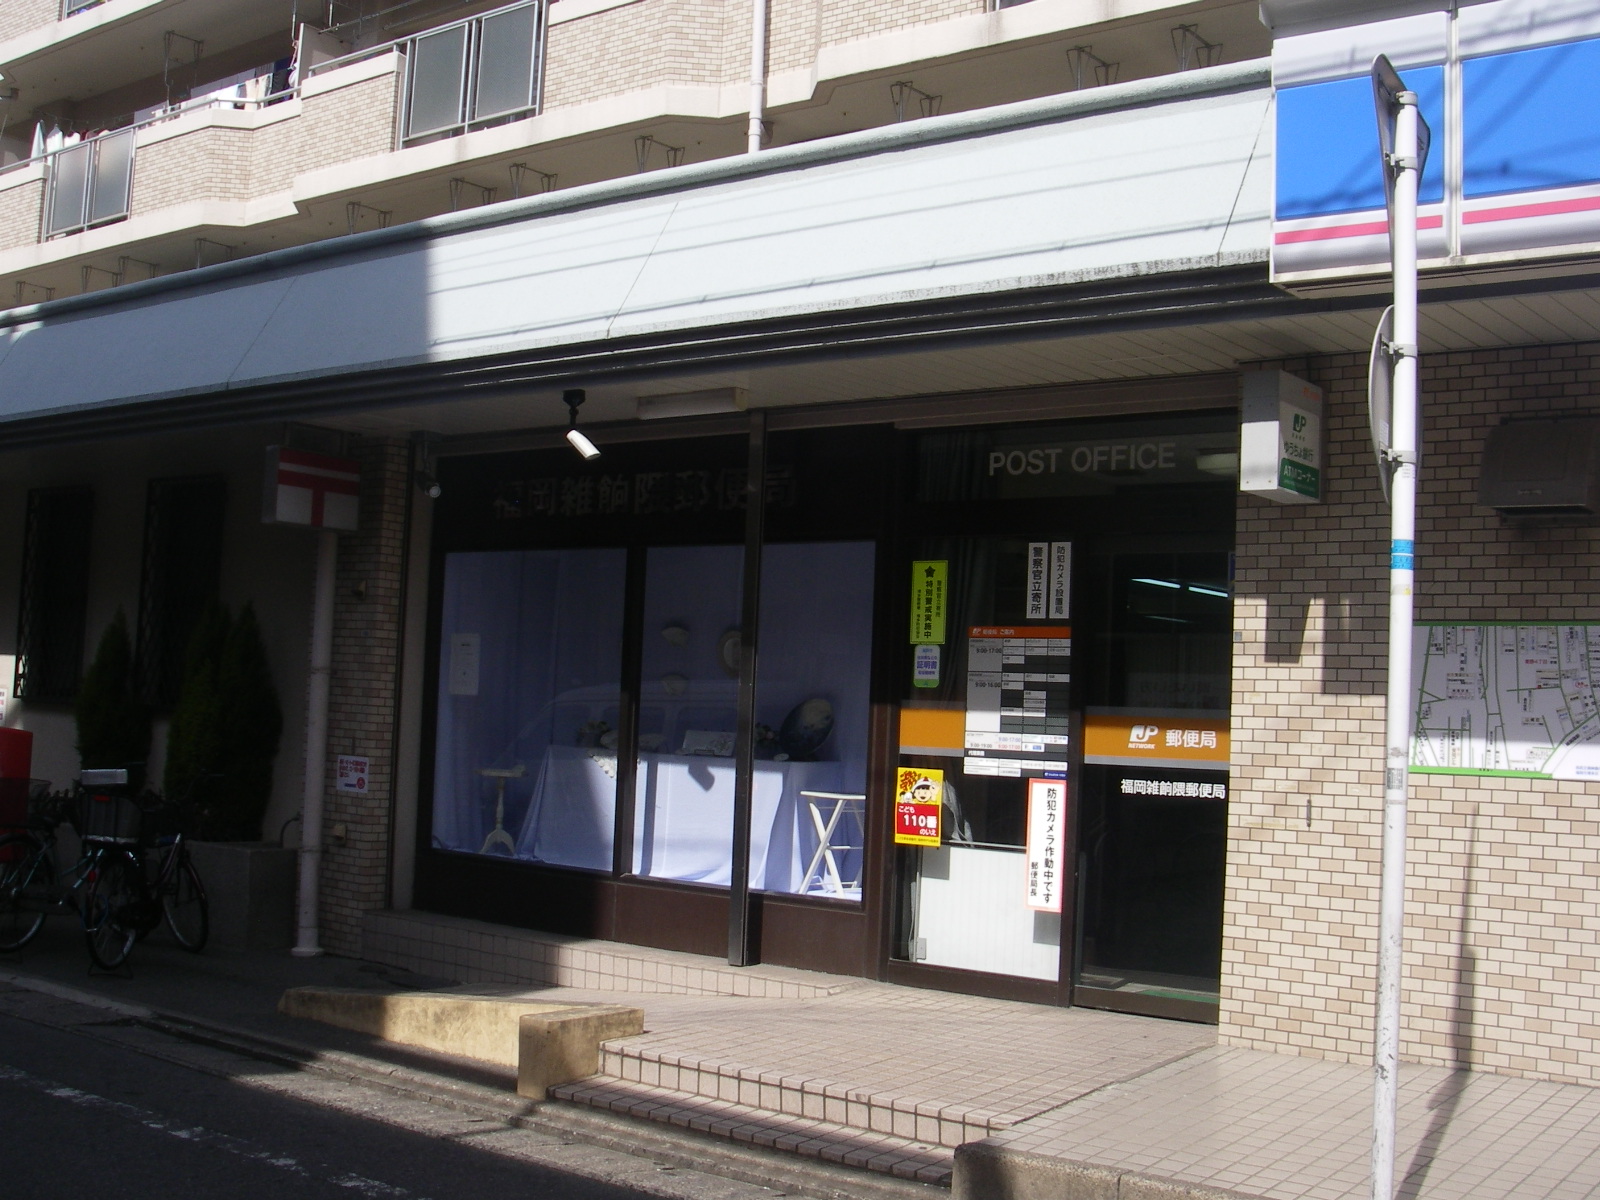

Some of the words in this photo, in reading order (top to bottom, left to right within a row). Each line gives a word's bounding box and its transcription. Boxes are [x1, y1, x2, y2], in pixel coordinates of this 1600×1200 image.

[989, 448, 1063, 476] POST
[1071, 443, 1176, 472] OFFICE
[1284, 441, 1314, 463] ゆうちょ銀行
[1284, 465, 1316, 482] ATMコーナー
[1031, 547, 1043, 614] 警察官立寄所
[1055, 546, 1065, 614] 防犯カメラ設置局
[924, 581, 933, 639] 特別警戒実施中
[916, 660, 937, 669] 証明書
[1129, 725, 1158, 742] JP
[1166, 729, 1216, 749] 郵便局
[1120, 779, 1226, 799] 福岡雑餉隈郵便局
[898, 805, 915, 814] こども
[903, 814, 937, 828] 110番
[919, 828, 937, 836] のいえ
[1043, 788, 1057, 904] 防犯カメラ作動中です
[1030, 861, 1039, 897] 郵便局長
